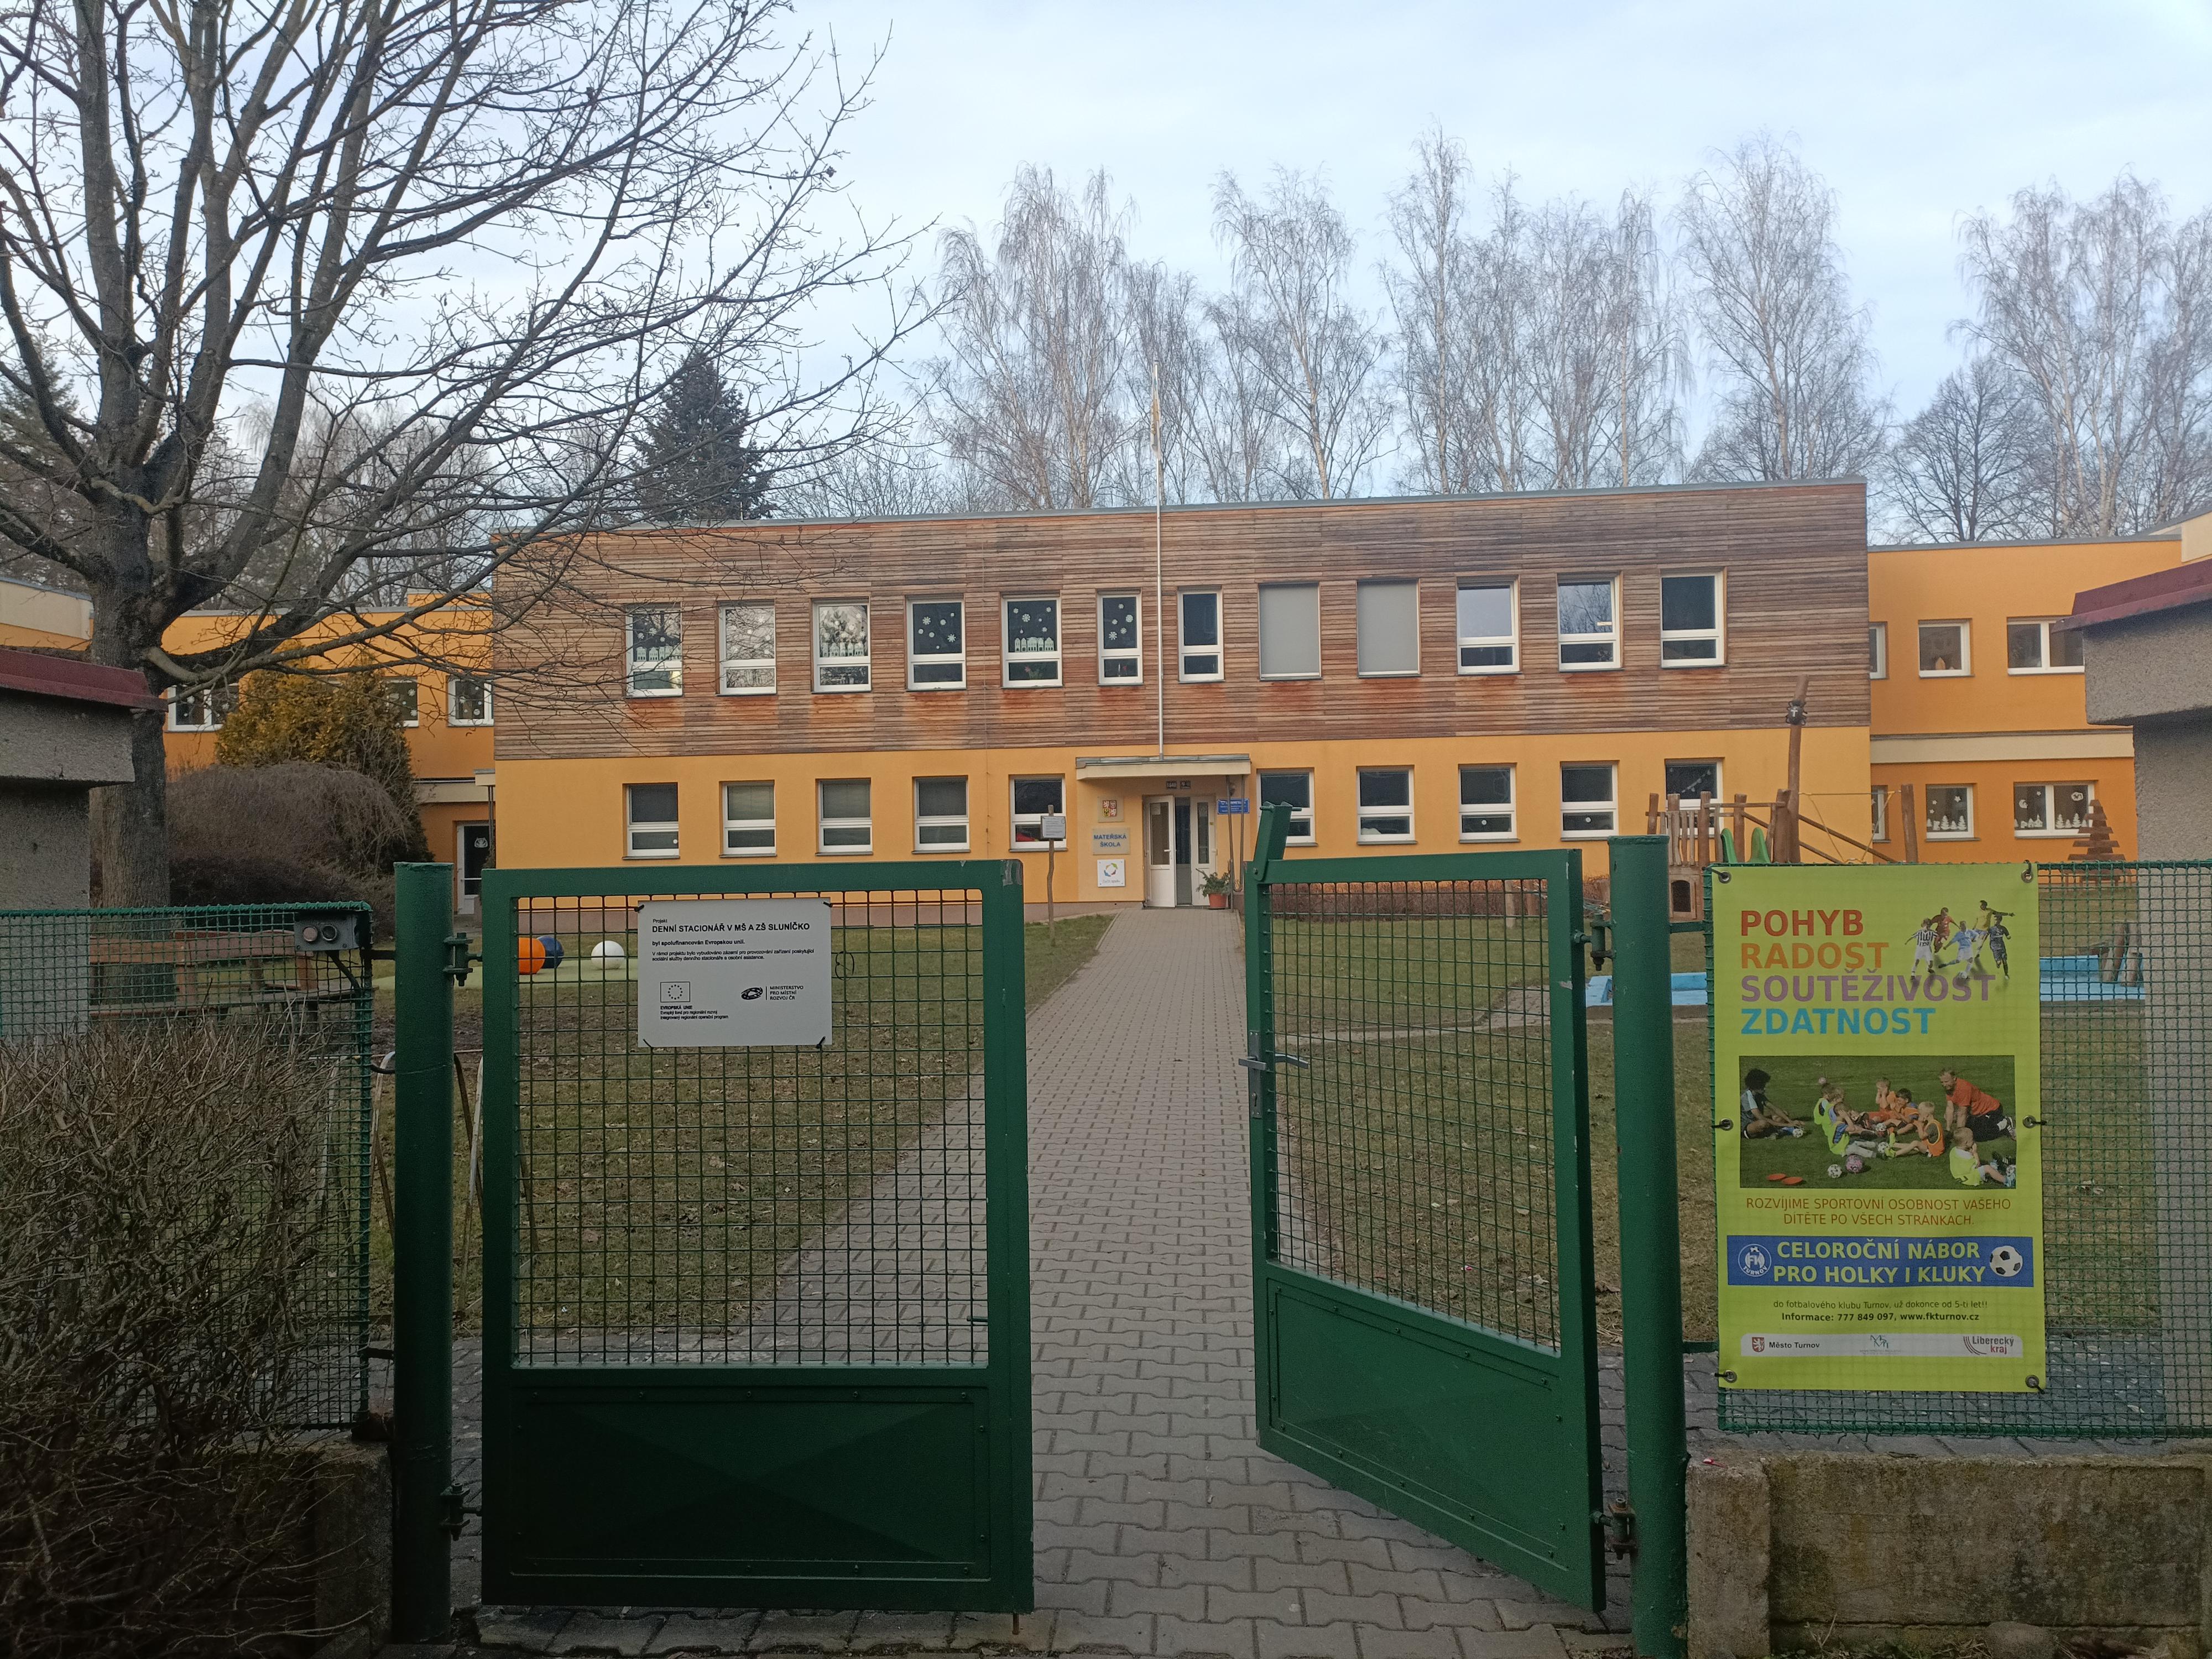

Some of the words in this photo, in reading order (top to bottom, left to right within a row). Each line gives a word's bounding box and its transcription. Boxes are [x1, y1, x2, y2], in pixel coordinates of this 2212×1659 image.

[653, 924, 676, 932] DENNÍ
[679, 923, 724, 932] STACIONÁŘ
[734, 923, 746, 931] MŠ
[755, 922, 766, 931] ZŠ
[768, 922, 810, 931] SLUNÍČKO
[1741, 910, 1863, 936] POHYB
[1741, 942, 1889, 969] RADOST
[1741, 968, 1995, 1002] SOUTĚŽIVOST
[1741, 1008, 1936, 1035] ZDATNOST
[1746, 1196, 1809, 1211] ROZVÍJÍME
[1814, 1197, 1884, 1209] SPORTOVNÍ
[1888, 1198, 1959, 1210] OSOBNOST
[1963, 1197, 2011, 1210] VAŠEHO
[1784, 1212, 1826, 1224] DÍTĚTE
[1831, 1214, 1847, 1224] PO
[1852, 1212, 1892, 1225] VŠECH
[1898, 1213, 1974, 1225] STRÁNKÁCH.
[1777, 1239, 1900, 1259] CELOROČNÍ
[1908, 1239, 1980, 1259] NÁBOR
[1743, 1265, 1767, 1275] TURNOV
[1773, 1265, 1817, 1282] PRO
[1825, 1266, 1898, 1283] HOLKY
[1906, 1267, 1910, 1283] I
[1918, 1266, 1986, 1282] KLUKY
[1787, 1300, 1836, 1308] fotbalového
[1782, 1313, 1834, 1321] Informace:
[1877, 1313, 1897, 1321] 097,
[1900, 1312, 1979, 1321] www.fkturnov.cz
[1972, 1335, 2014, 1347] Liberecký
[1990, 1345, 2007, 1355] kraj
